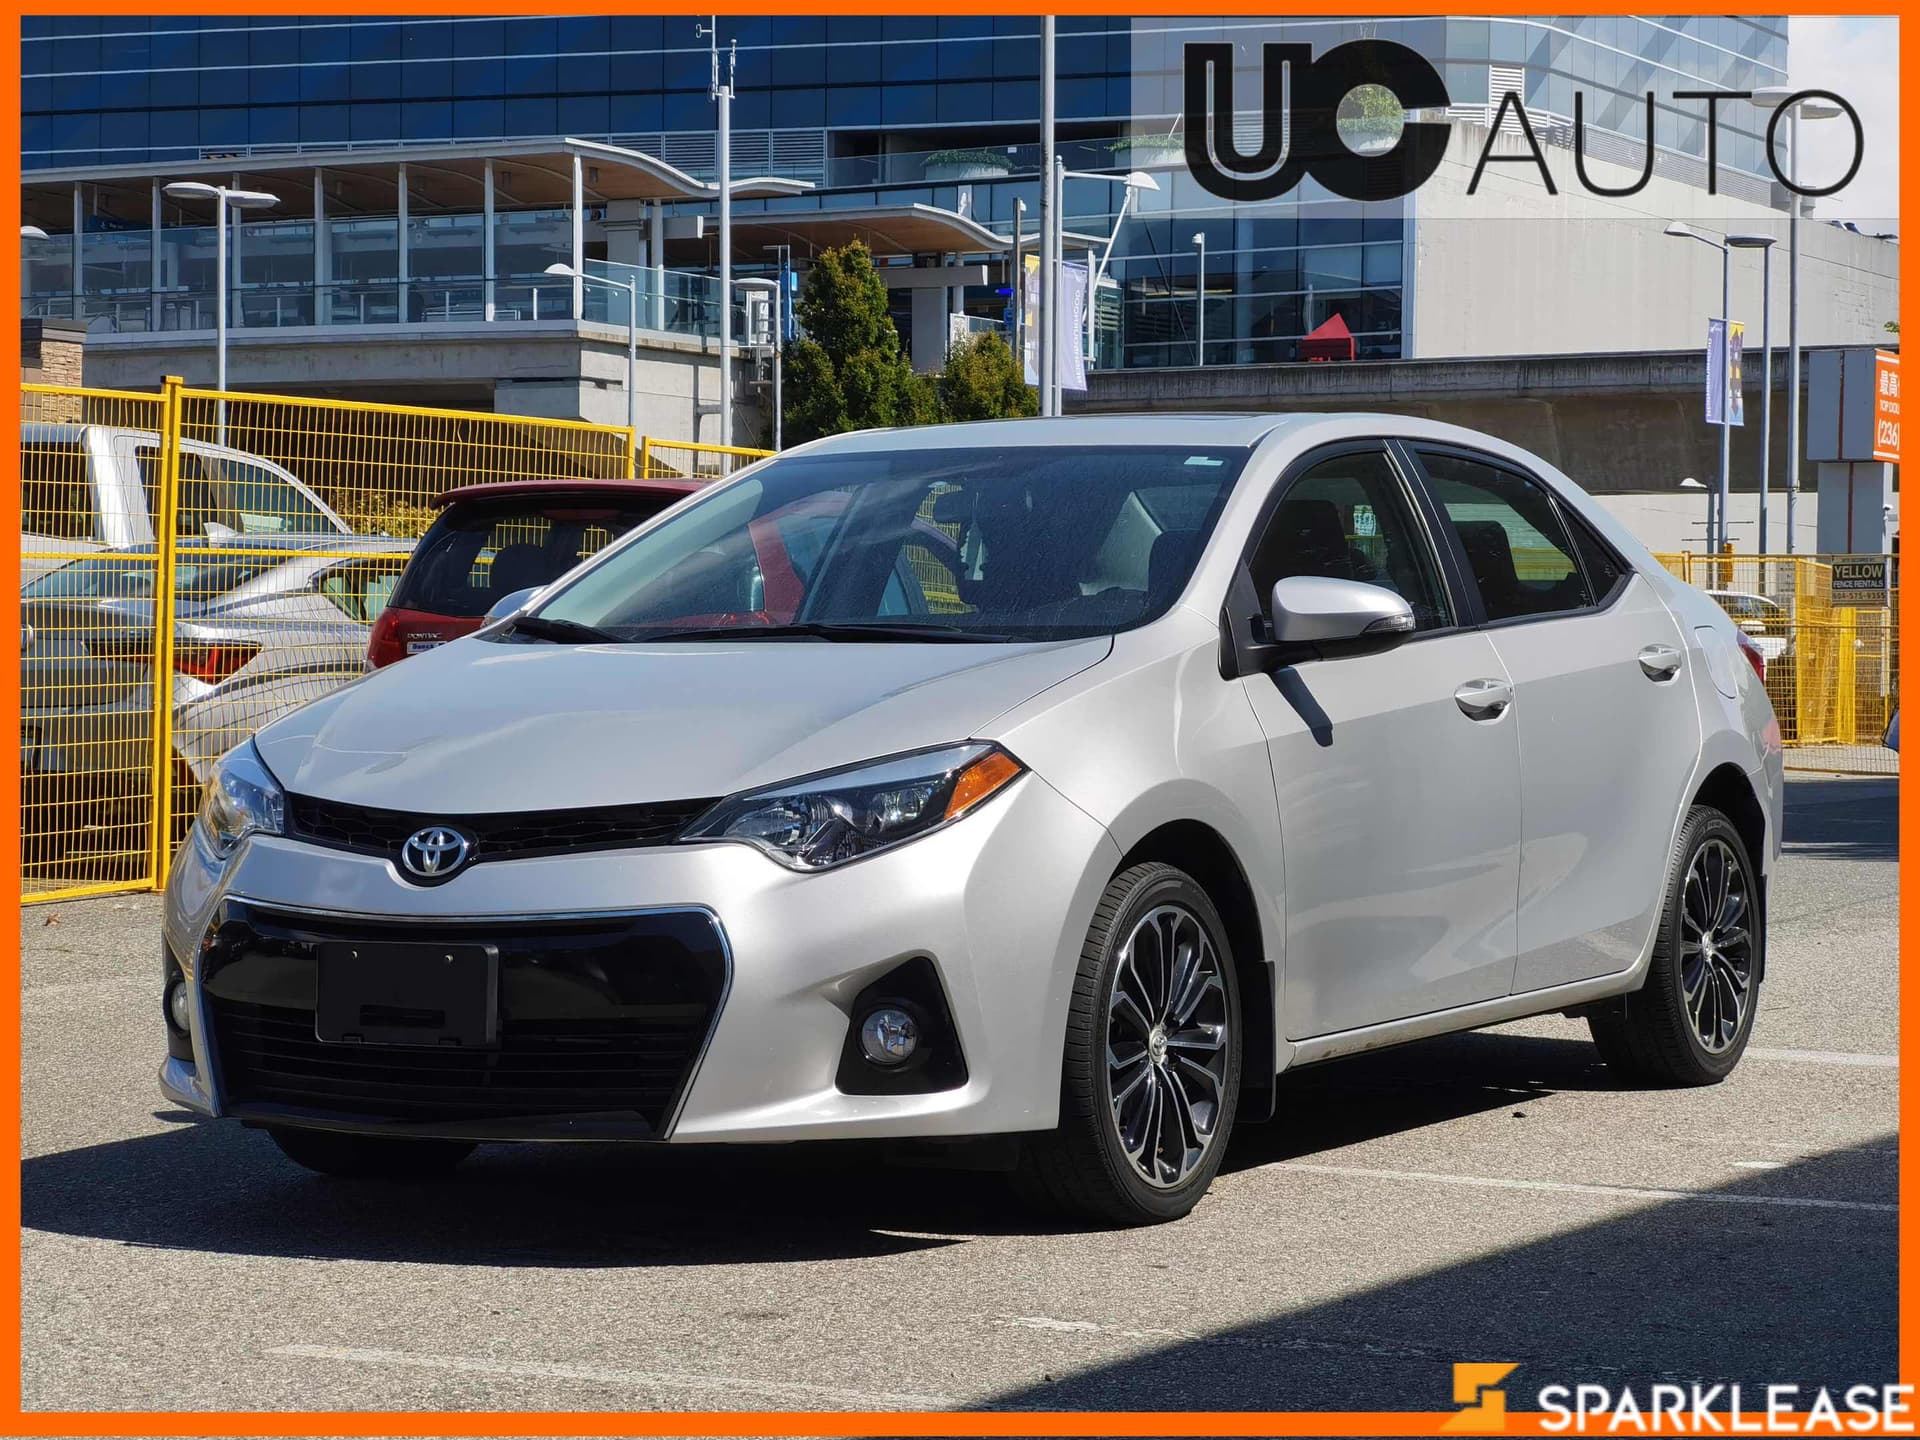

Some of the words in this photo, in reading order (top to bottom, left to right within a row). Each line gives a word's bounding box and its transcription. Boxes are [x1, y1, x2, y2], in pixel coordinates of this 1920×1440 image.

[1880, 369, 1899, 397] 最高
[1834, 564, 1883, 578] YELLOW
[1833, 580, 1853, 588] FENCE
[1854, 580, 1884, 588] RENTALS
